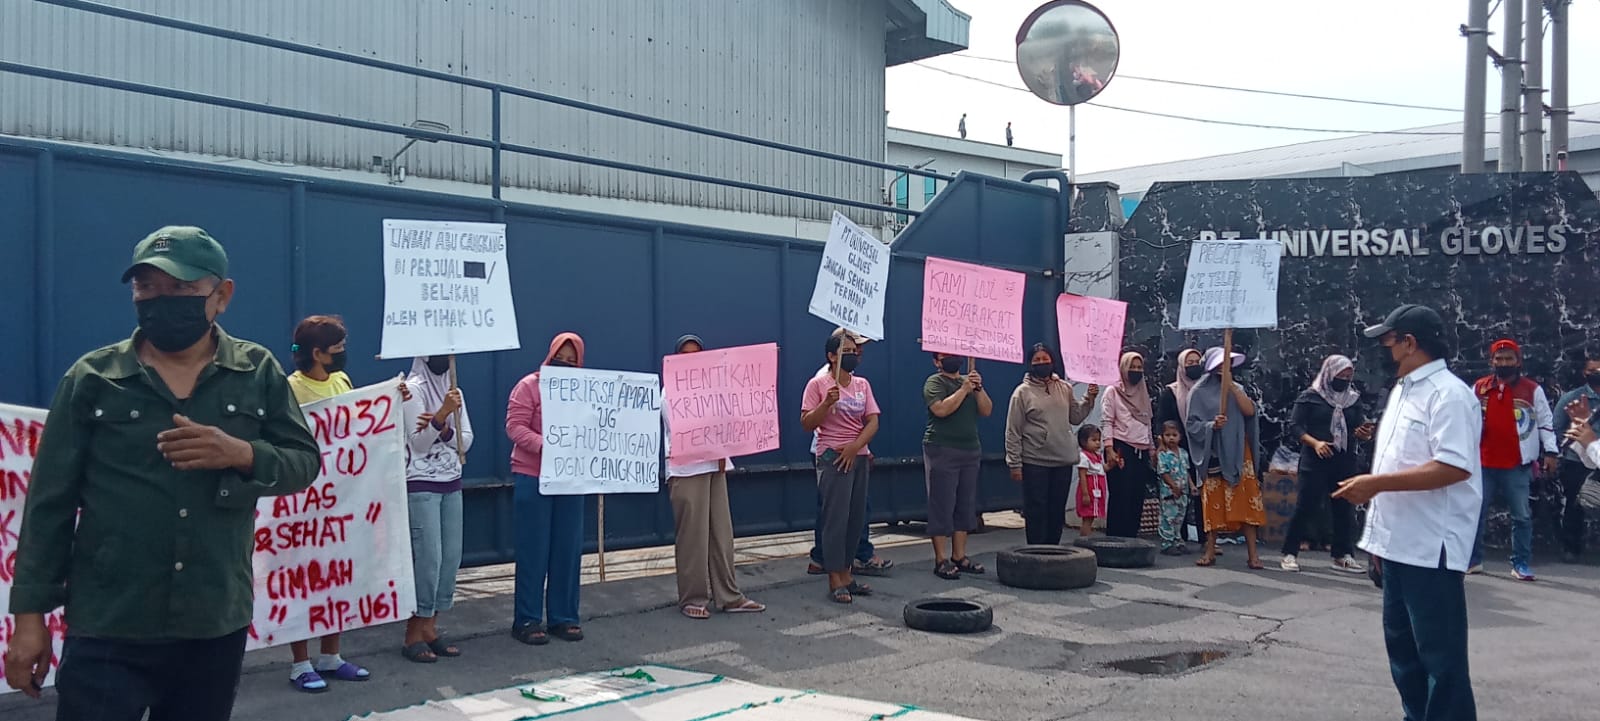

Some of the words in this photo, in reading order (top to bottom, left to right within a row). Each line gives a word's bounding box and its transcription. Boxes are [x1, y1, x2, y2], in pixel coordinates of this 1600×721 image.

[435, 231, 457, 251] ABU
[1440, 225, 1567, 256] GLOVES
[929, 268, 967, 298] KAMI
[424, 308, 467, 328] PIHAK
[472, 308, 495, 328] UG
[928, 294, 1015, 329] MASYARAKAT
[548, 376, 615, 406] PERIKSA
[675, 362, 762, 392] HENTIKAN
[669, 384, 777, 420] KRIMINALISASI
[546, 424, 658, 458] SEHUBUNGAN
[554, 456, 585, 478] DGN
[589, 456, 658, 485] CANGKANG
